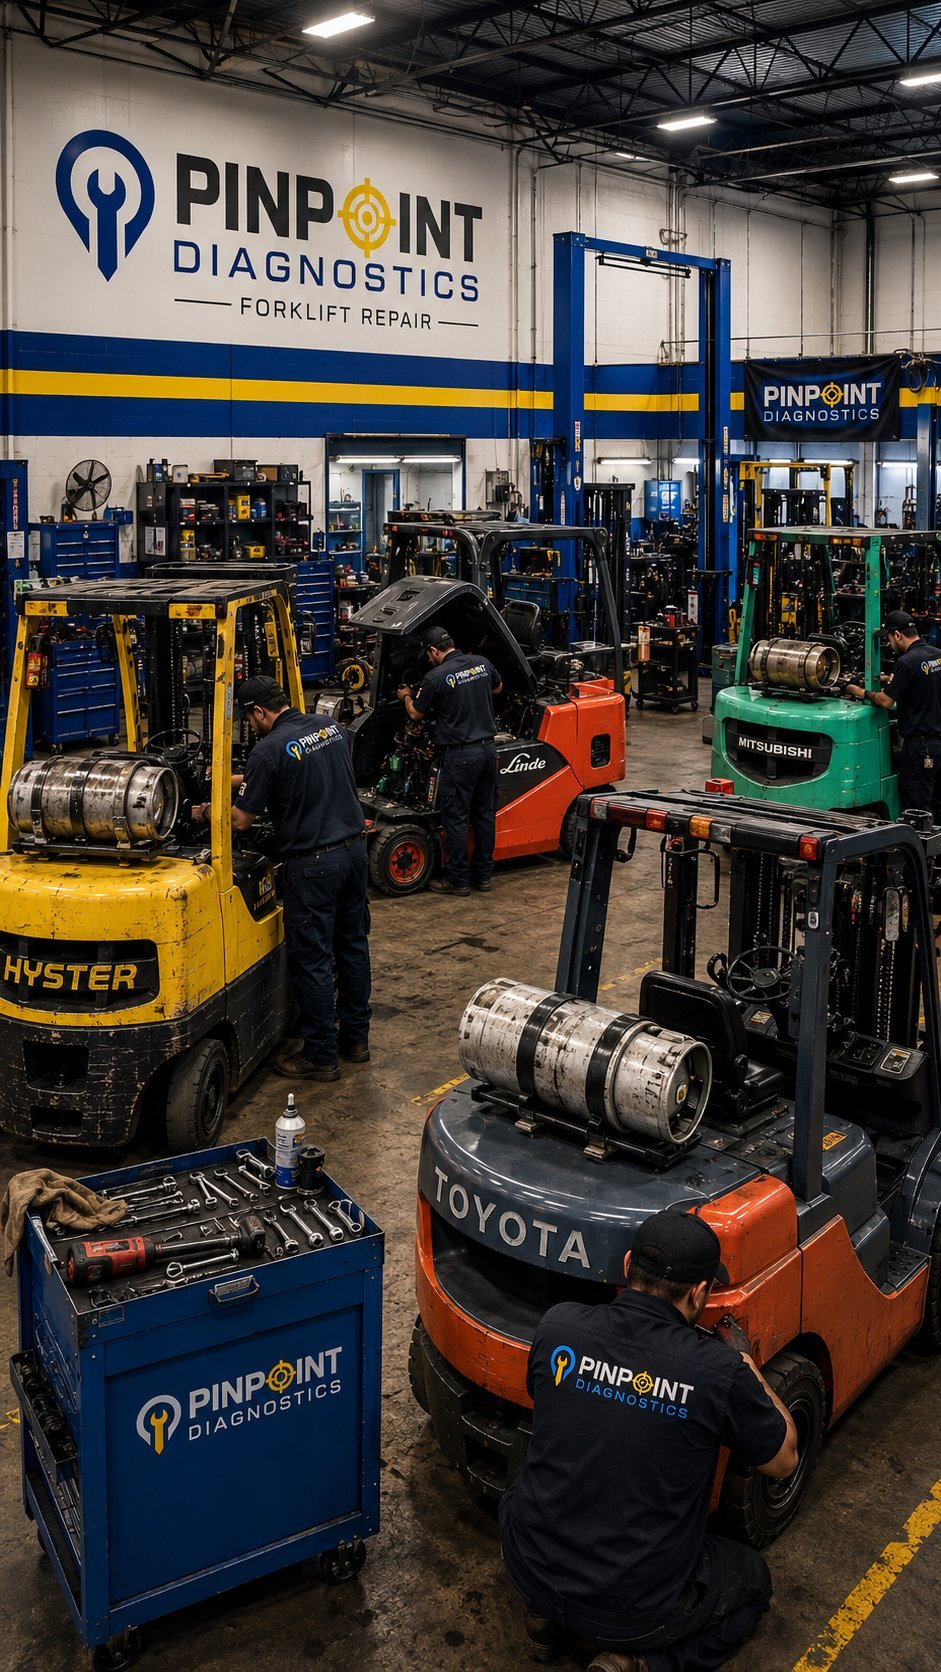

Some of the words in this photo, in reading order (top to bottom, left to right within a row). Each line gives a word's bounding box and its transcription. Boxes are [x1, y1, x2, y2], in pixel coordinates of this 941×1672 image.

[176, 153, 483, 262] PINPOINT
[174, 240, 479, 302] DIAGNOSTICS
[240, 297, 351, 324] FORKLIFT
[361, 308, 432, 329] REPAIR
[763, 408, 880, 422] DIAGNOSTICS
[764, 382, 881, 408] PINPOINT
[500, 753, 546, 775] Linde
[738, 736, 812, 759] MITSUBISHI
[3, 955, 138, 991] HYSTER
[434, 1166, 591, 1269] TOYOTA
[189, 1346, 342, 1419] PINPOINT
[575, 1378, 689, 1419] DIAGNOSTICS
[578, 1355, 694, 1405] PINPOINT
[189, 1380, 342, 1441] DIAGNOSTICS
